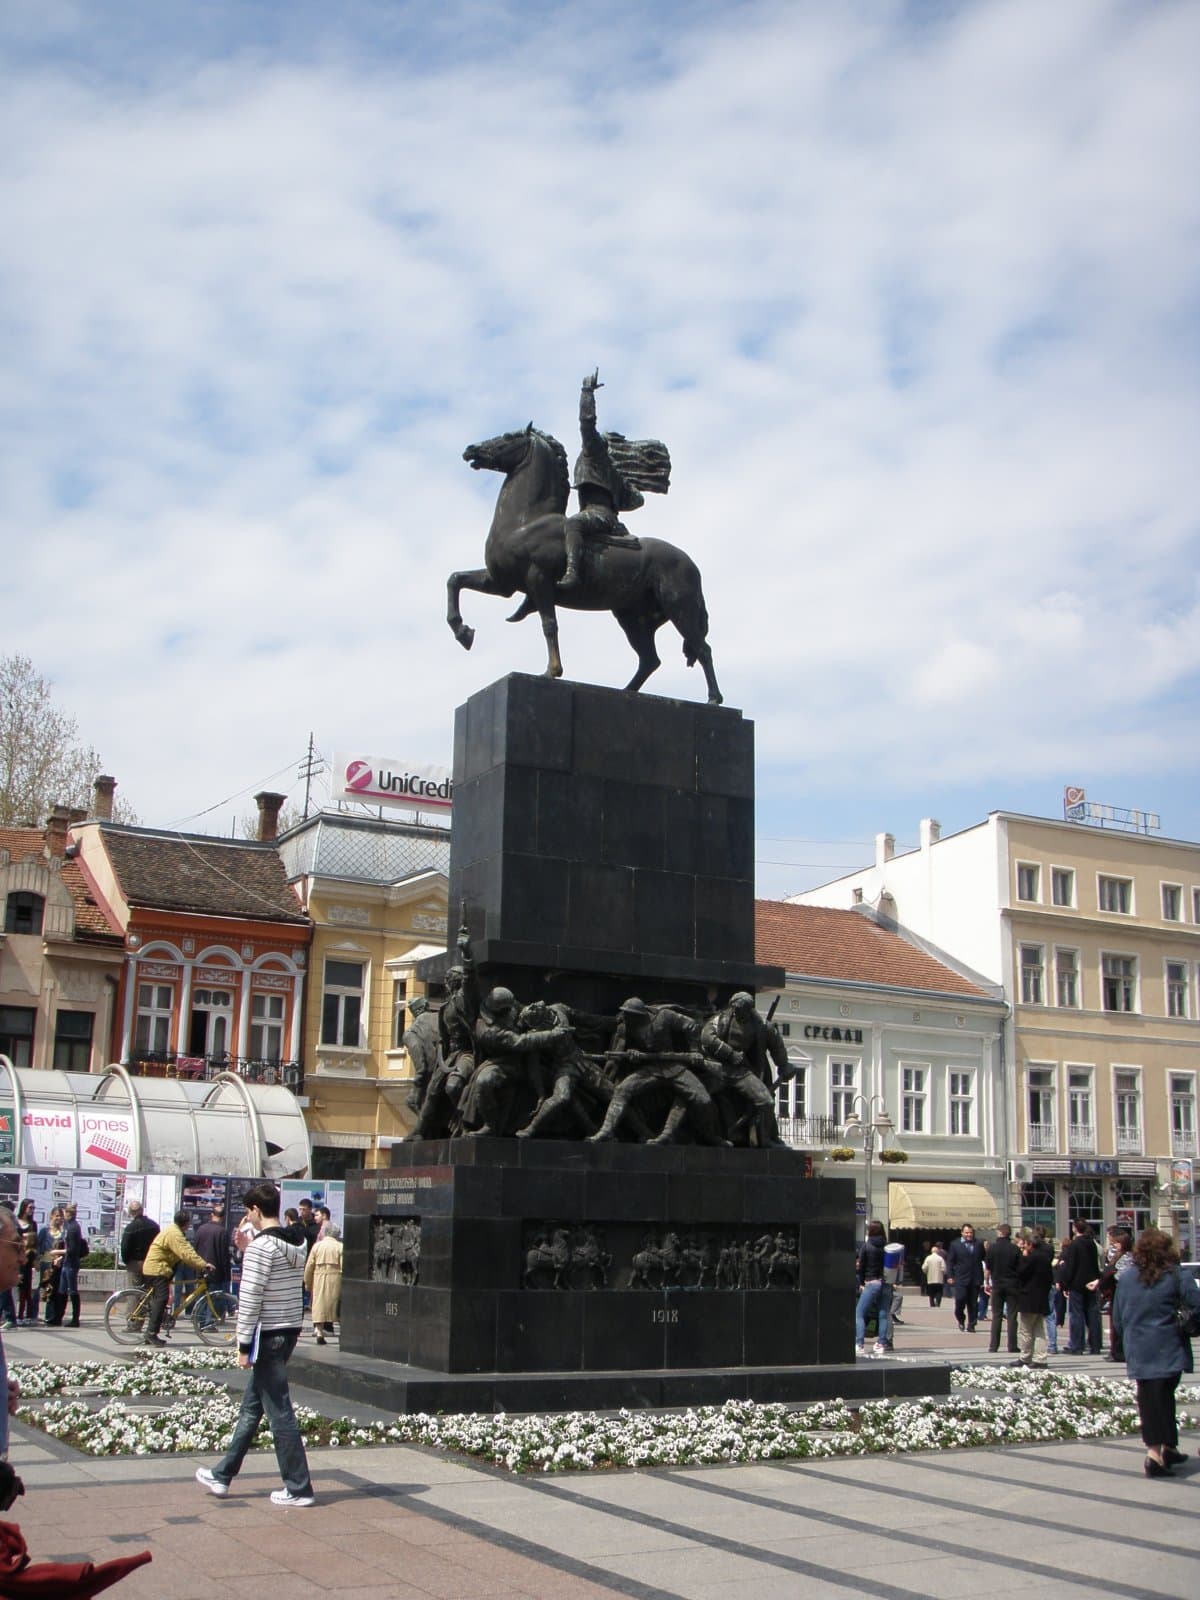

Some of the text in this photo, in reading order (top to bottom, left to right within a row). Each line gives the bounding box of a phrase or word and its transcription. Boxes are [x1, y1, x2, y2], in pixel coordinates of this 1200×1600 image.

[23, 1113, 72, 1128] david
[81, 1115, 129, 1134] jones
[652, 1309, 679, 1323] 1918
